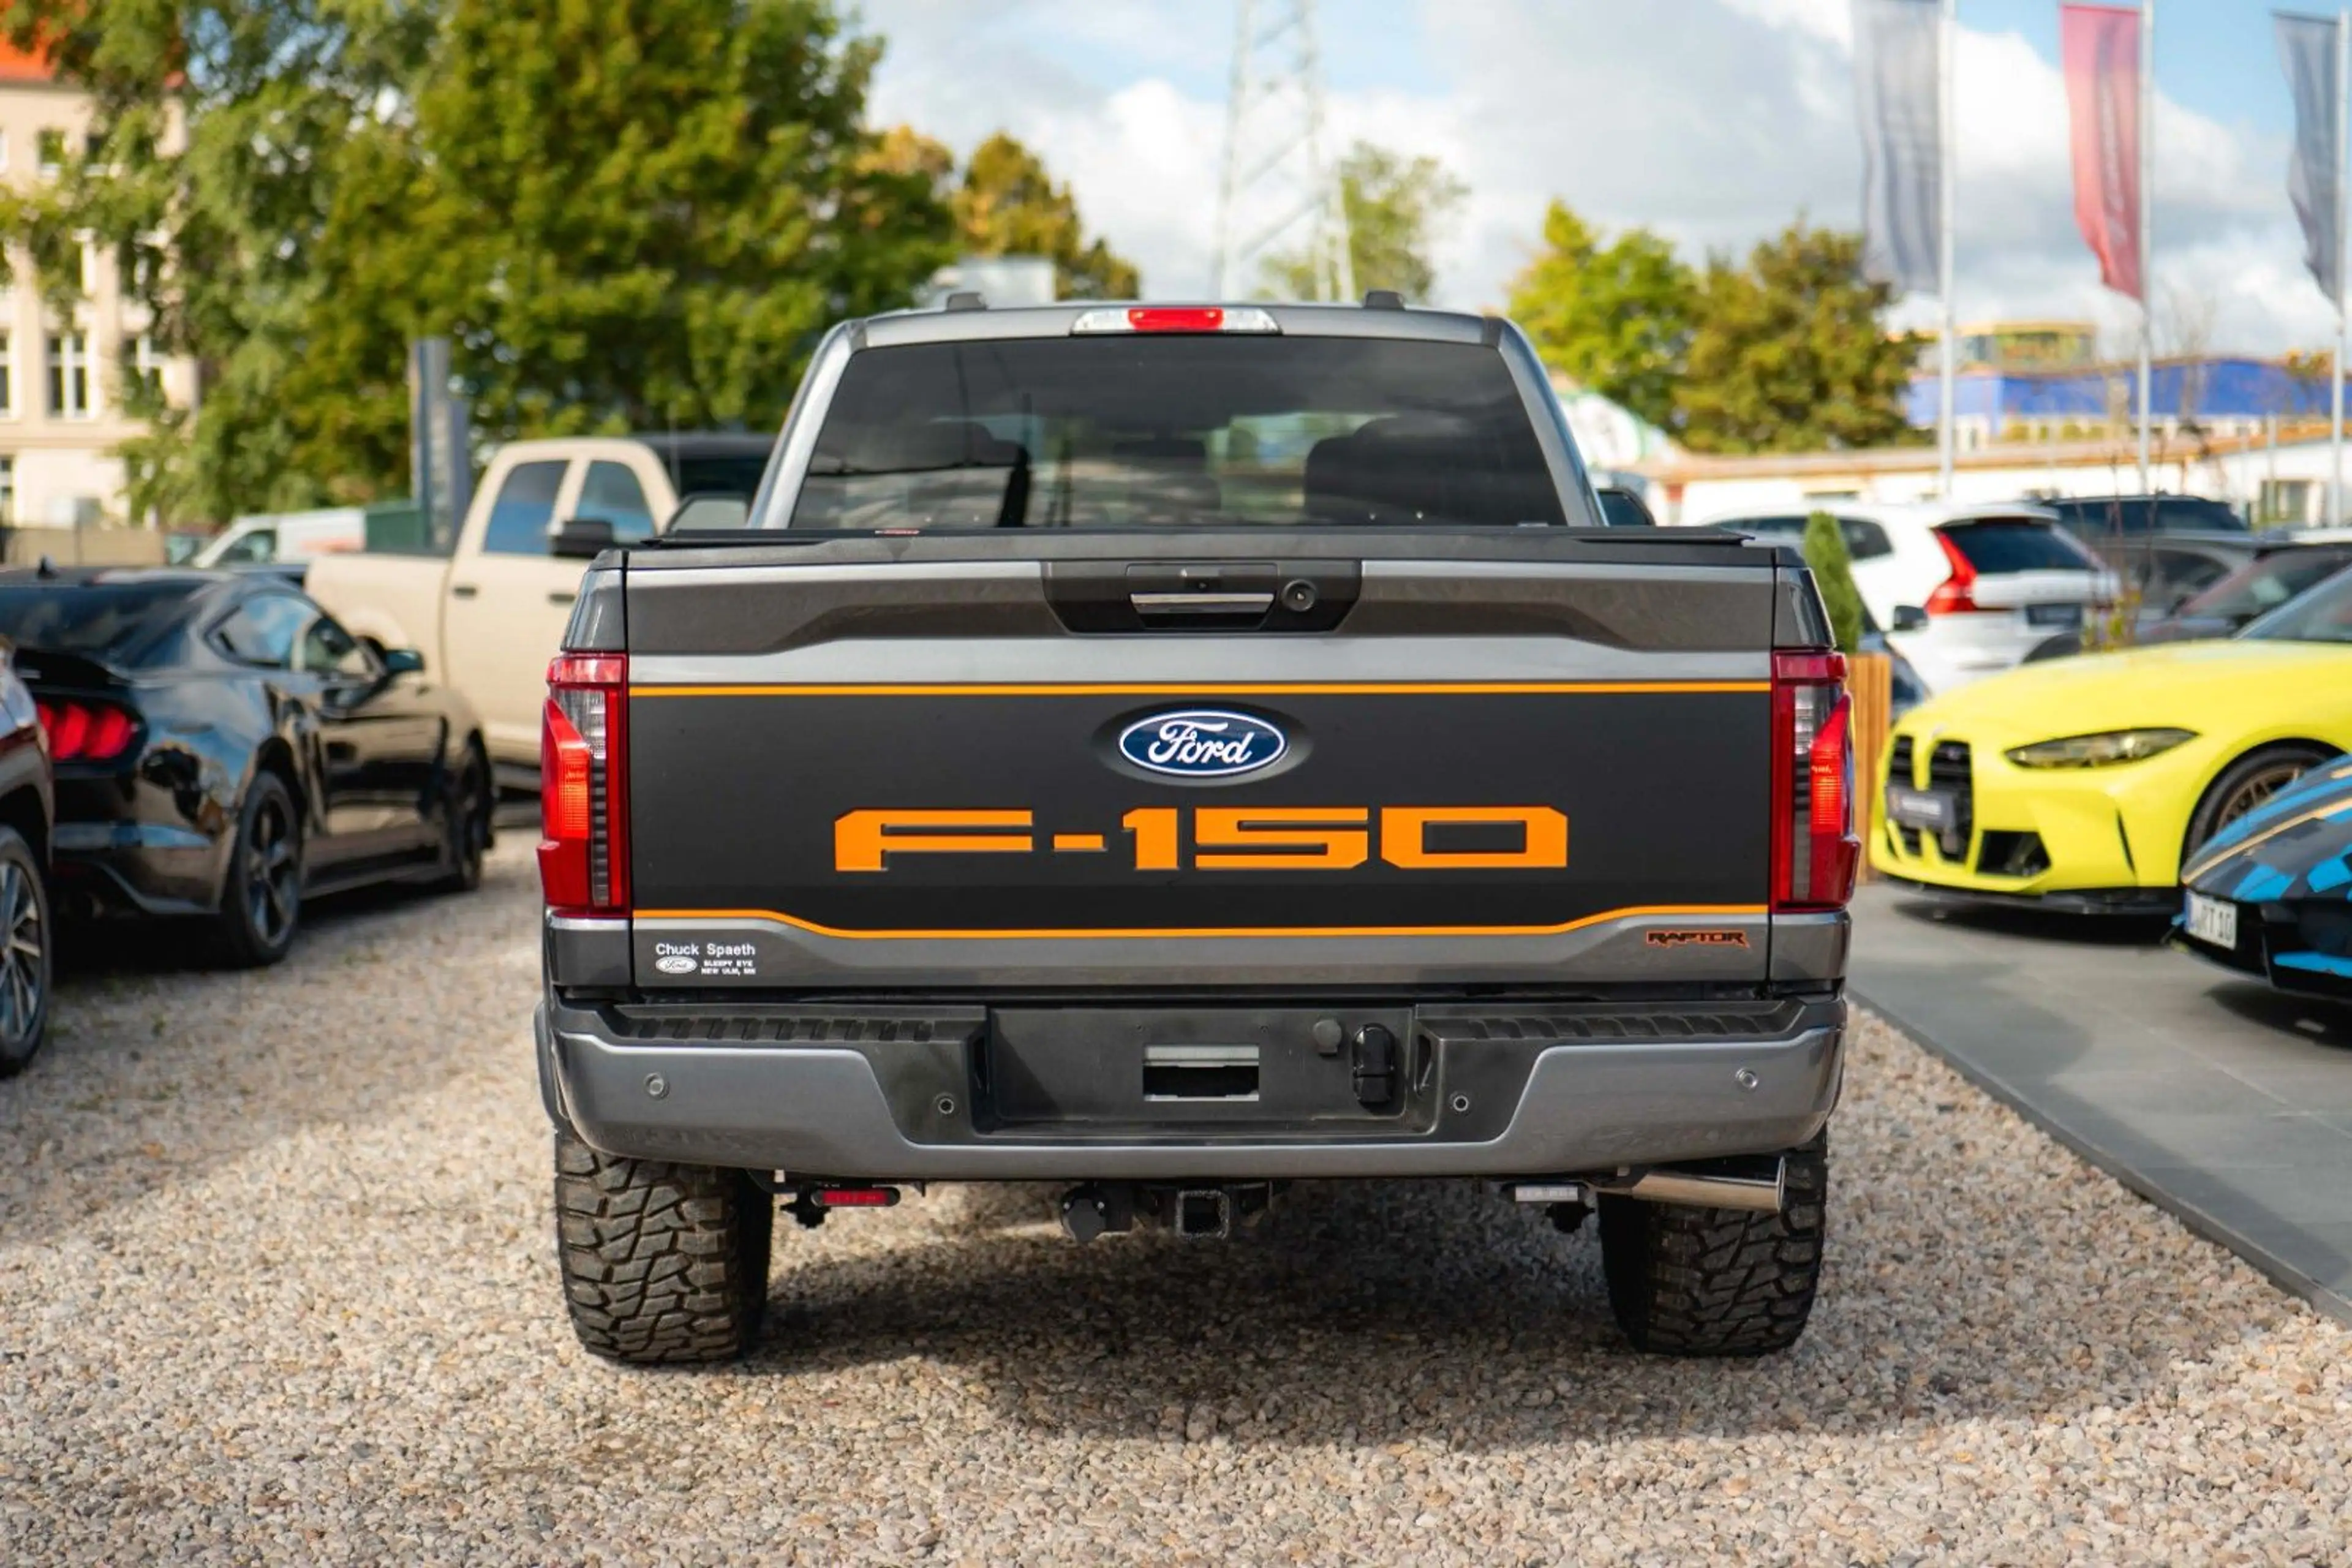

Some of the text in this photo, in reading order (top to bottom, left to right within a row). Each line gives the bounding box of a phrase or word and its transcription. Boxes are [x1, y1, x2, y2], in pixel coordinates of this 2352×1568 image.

[1148, 720, 1254, 764] Ford
[834, 806, 1568, 871] F-150
[655, 943, 756, 958] Chuck Spaeth
[1646, 930, 1749, 948] RAPTOR
